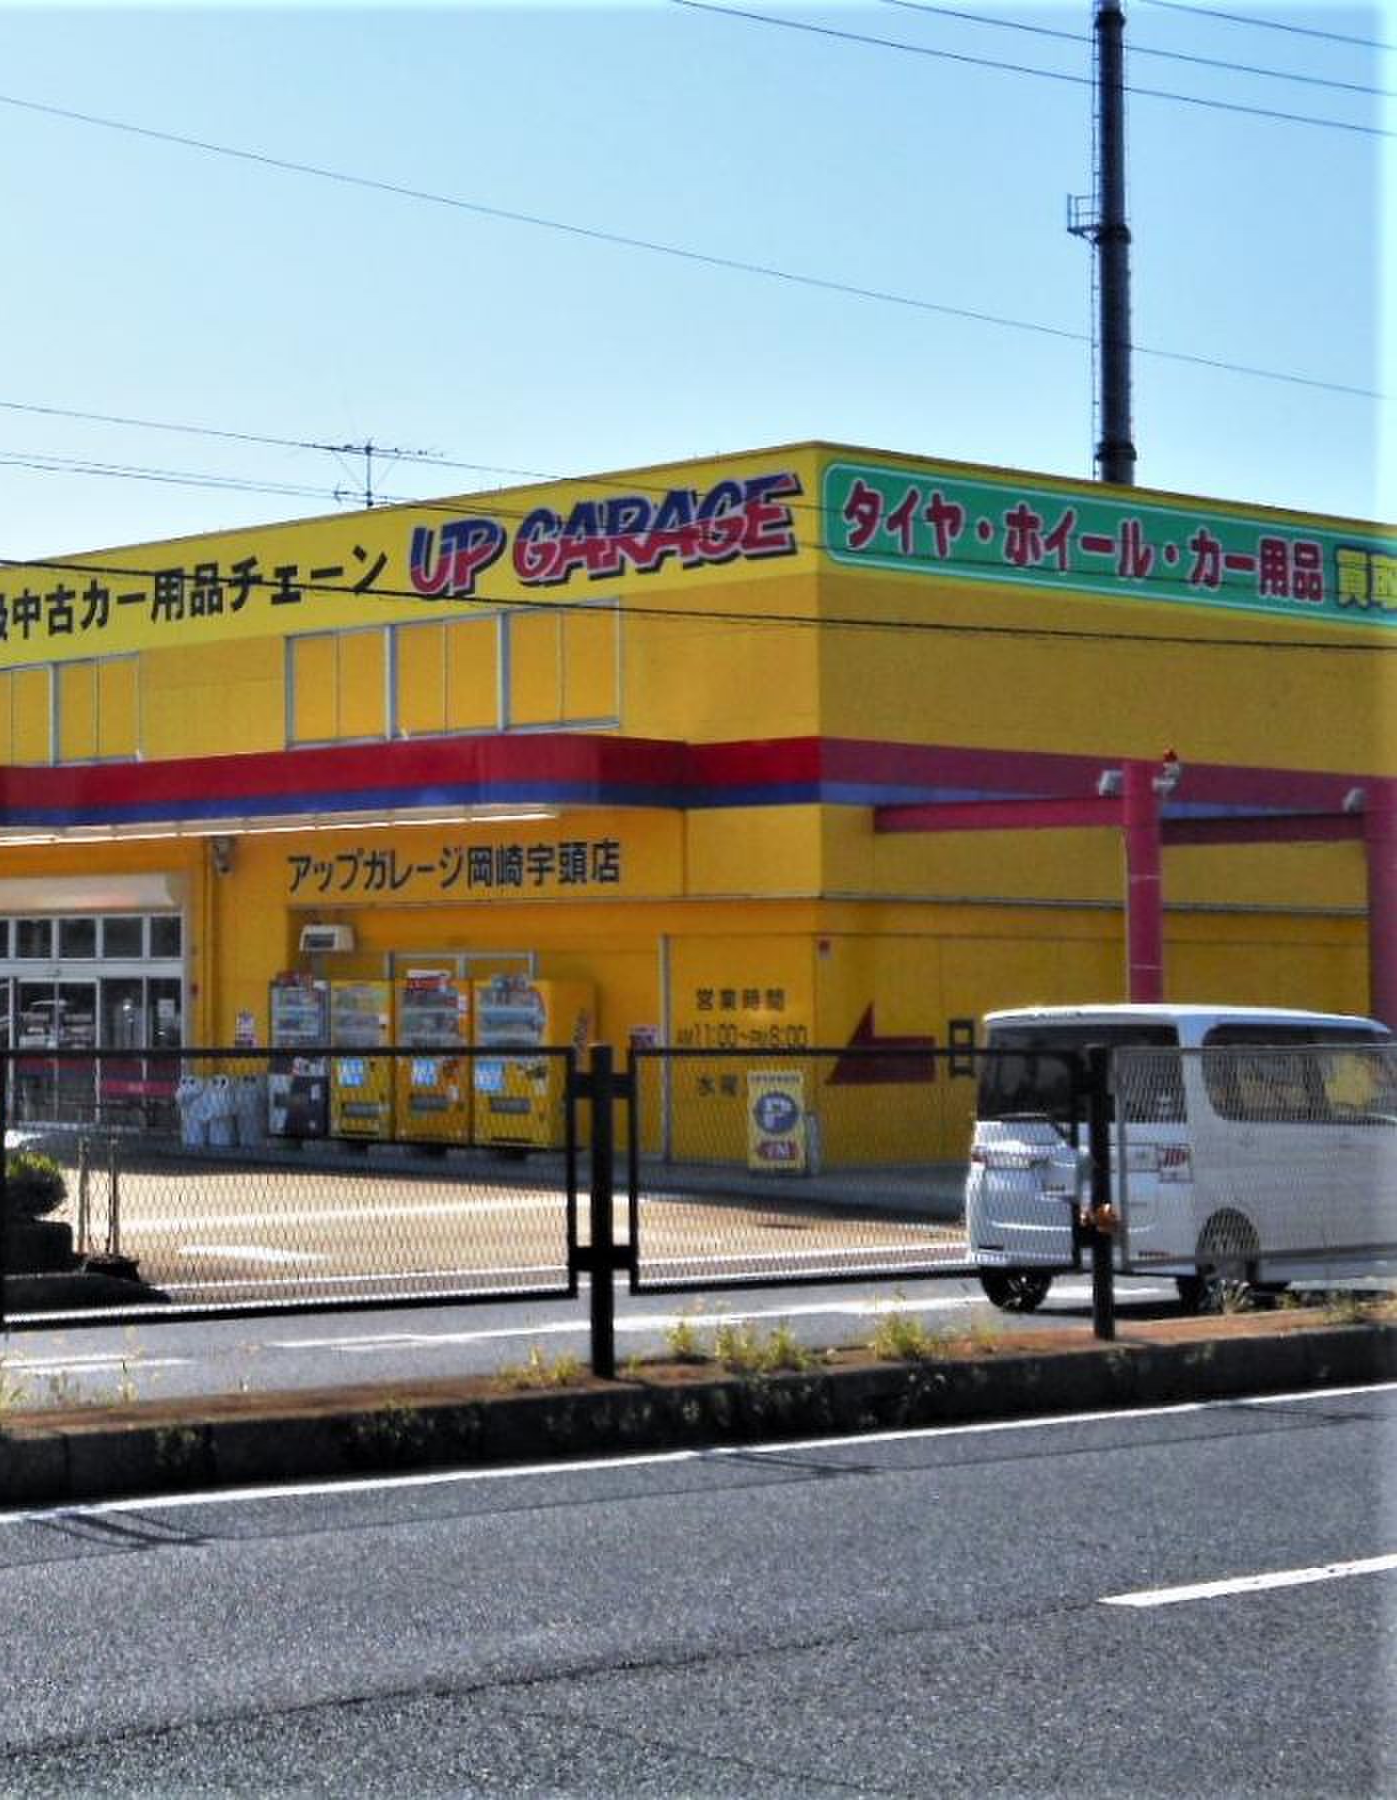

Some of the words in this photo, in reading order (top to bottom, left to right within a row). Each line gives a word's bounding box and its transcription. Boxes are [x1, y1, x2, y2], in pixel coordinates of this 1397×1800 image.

[409, 516, 506, 600] UP
[513, 473, 801, 582] GARAGE
[844, 479, 1324, 603] タイヤ・ホイール・カー用品
[287, 838, 620, 893] アップガレージ岡崎宇頭店
[696, 987, 785, 1012] 営業時間
